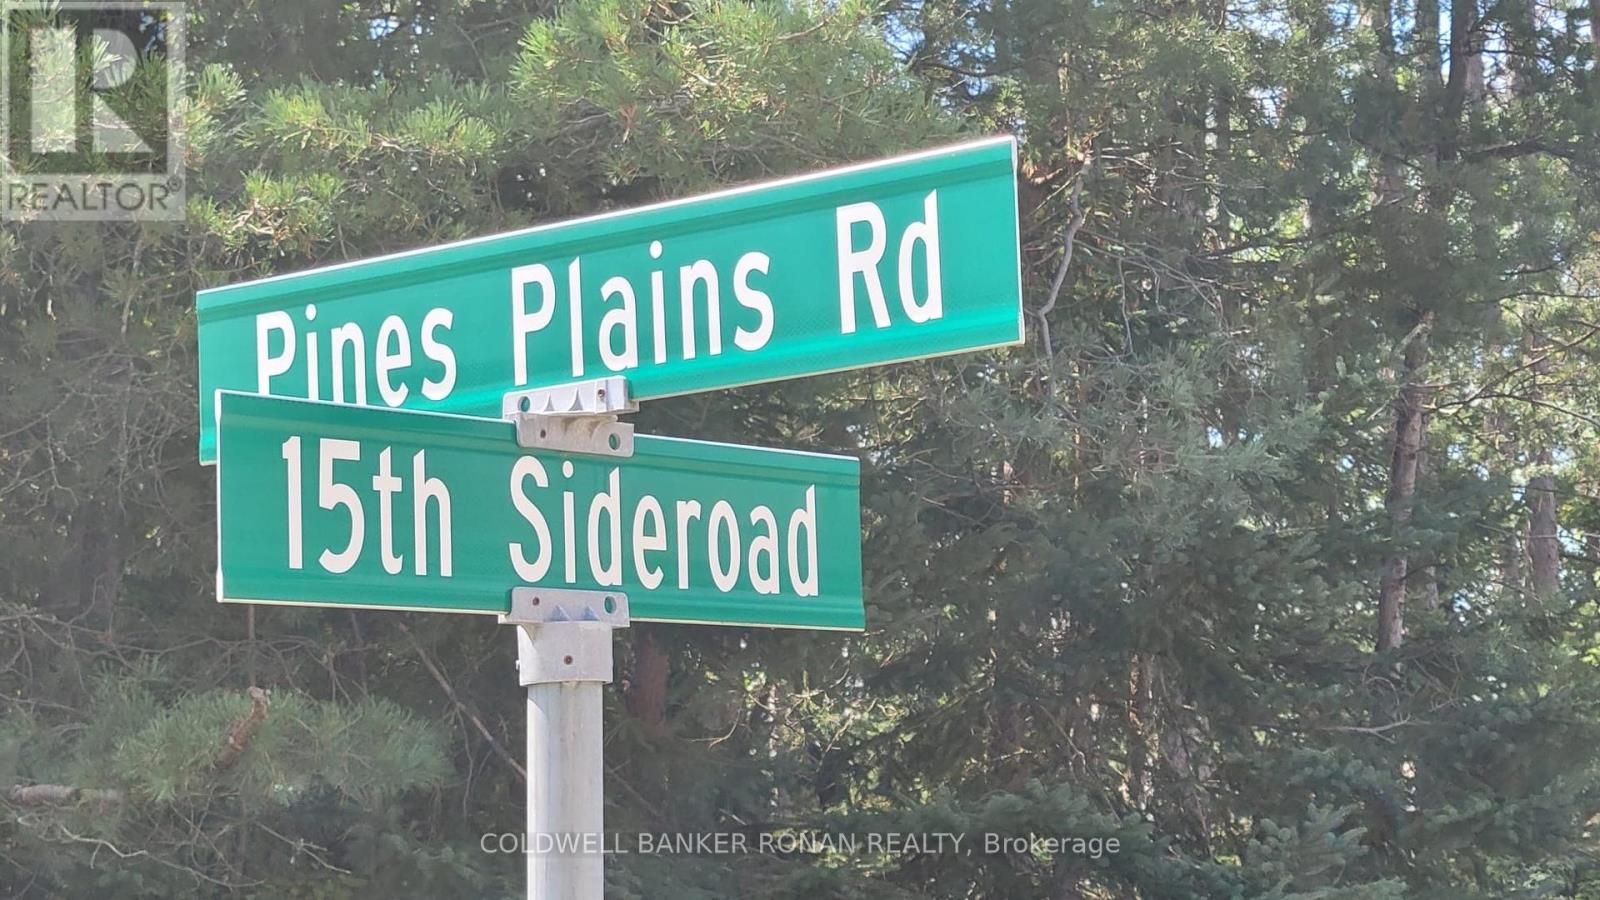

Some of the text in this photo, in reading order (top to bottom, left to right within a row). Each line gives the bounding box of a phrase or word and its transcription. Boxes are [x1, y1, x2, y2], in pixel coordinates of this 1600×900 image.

[256, 189, 944, 408] Pines Plains Rd
[281, 435, 820, 598] 15th Sideroad
